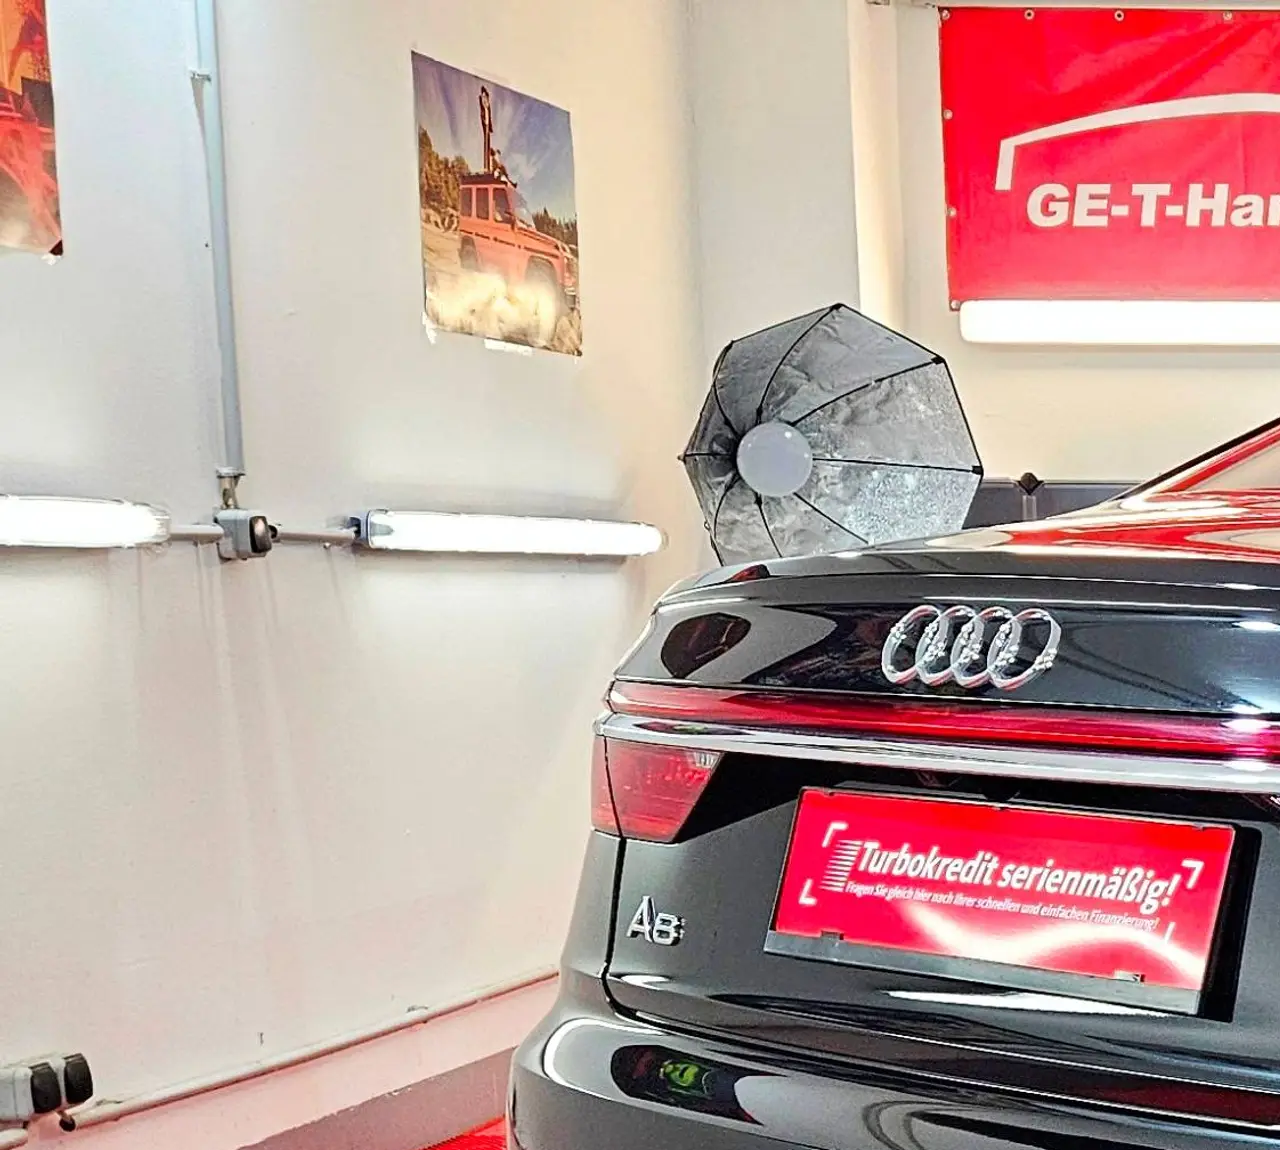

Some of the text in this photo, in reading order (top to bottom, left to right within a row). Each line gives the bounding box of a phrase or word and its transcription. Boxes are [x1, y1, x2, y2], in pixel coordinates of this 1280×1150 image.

[858, 840, 1182, 915] Turbokredit serienmäßig!
[626, 896, 682, 945] A8
[845, 881, 1160, 930] Fragen Sie gleich hier nach Ihrer schnellen und einfachen Finanzierung!
